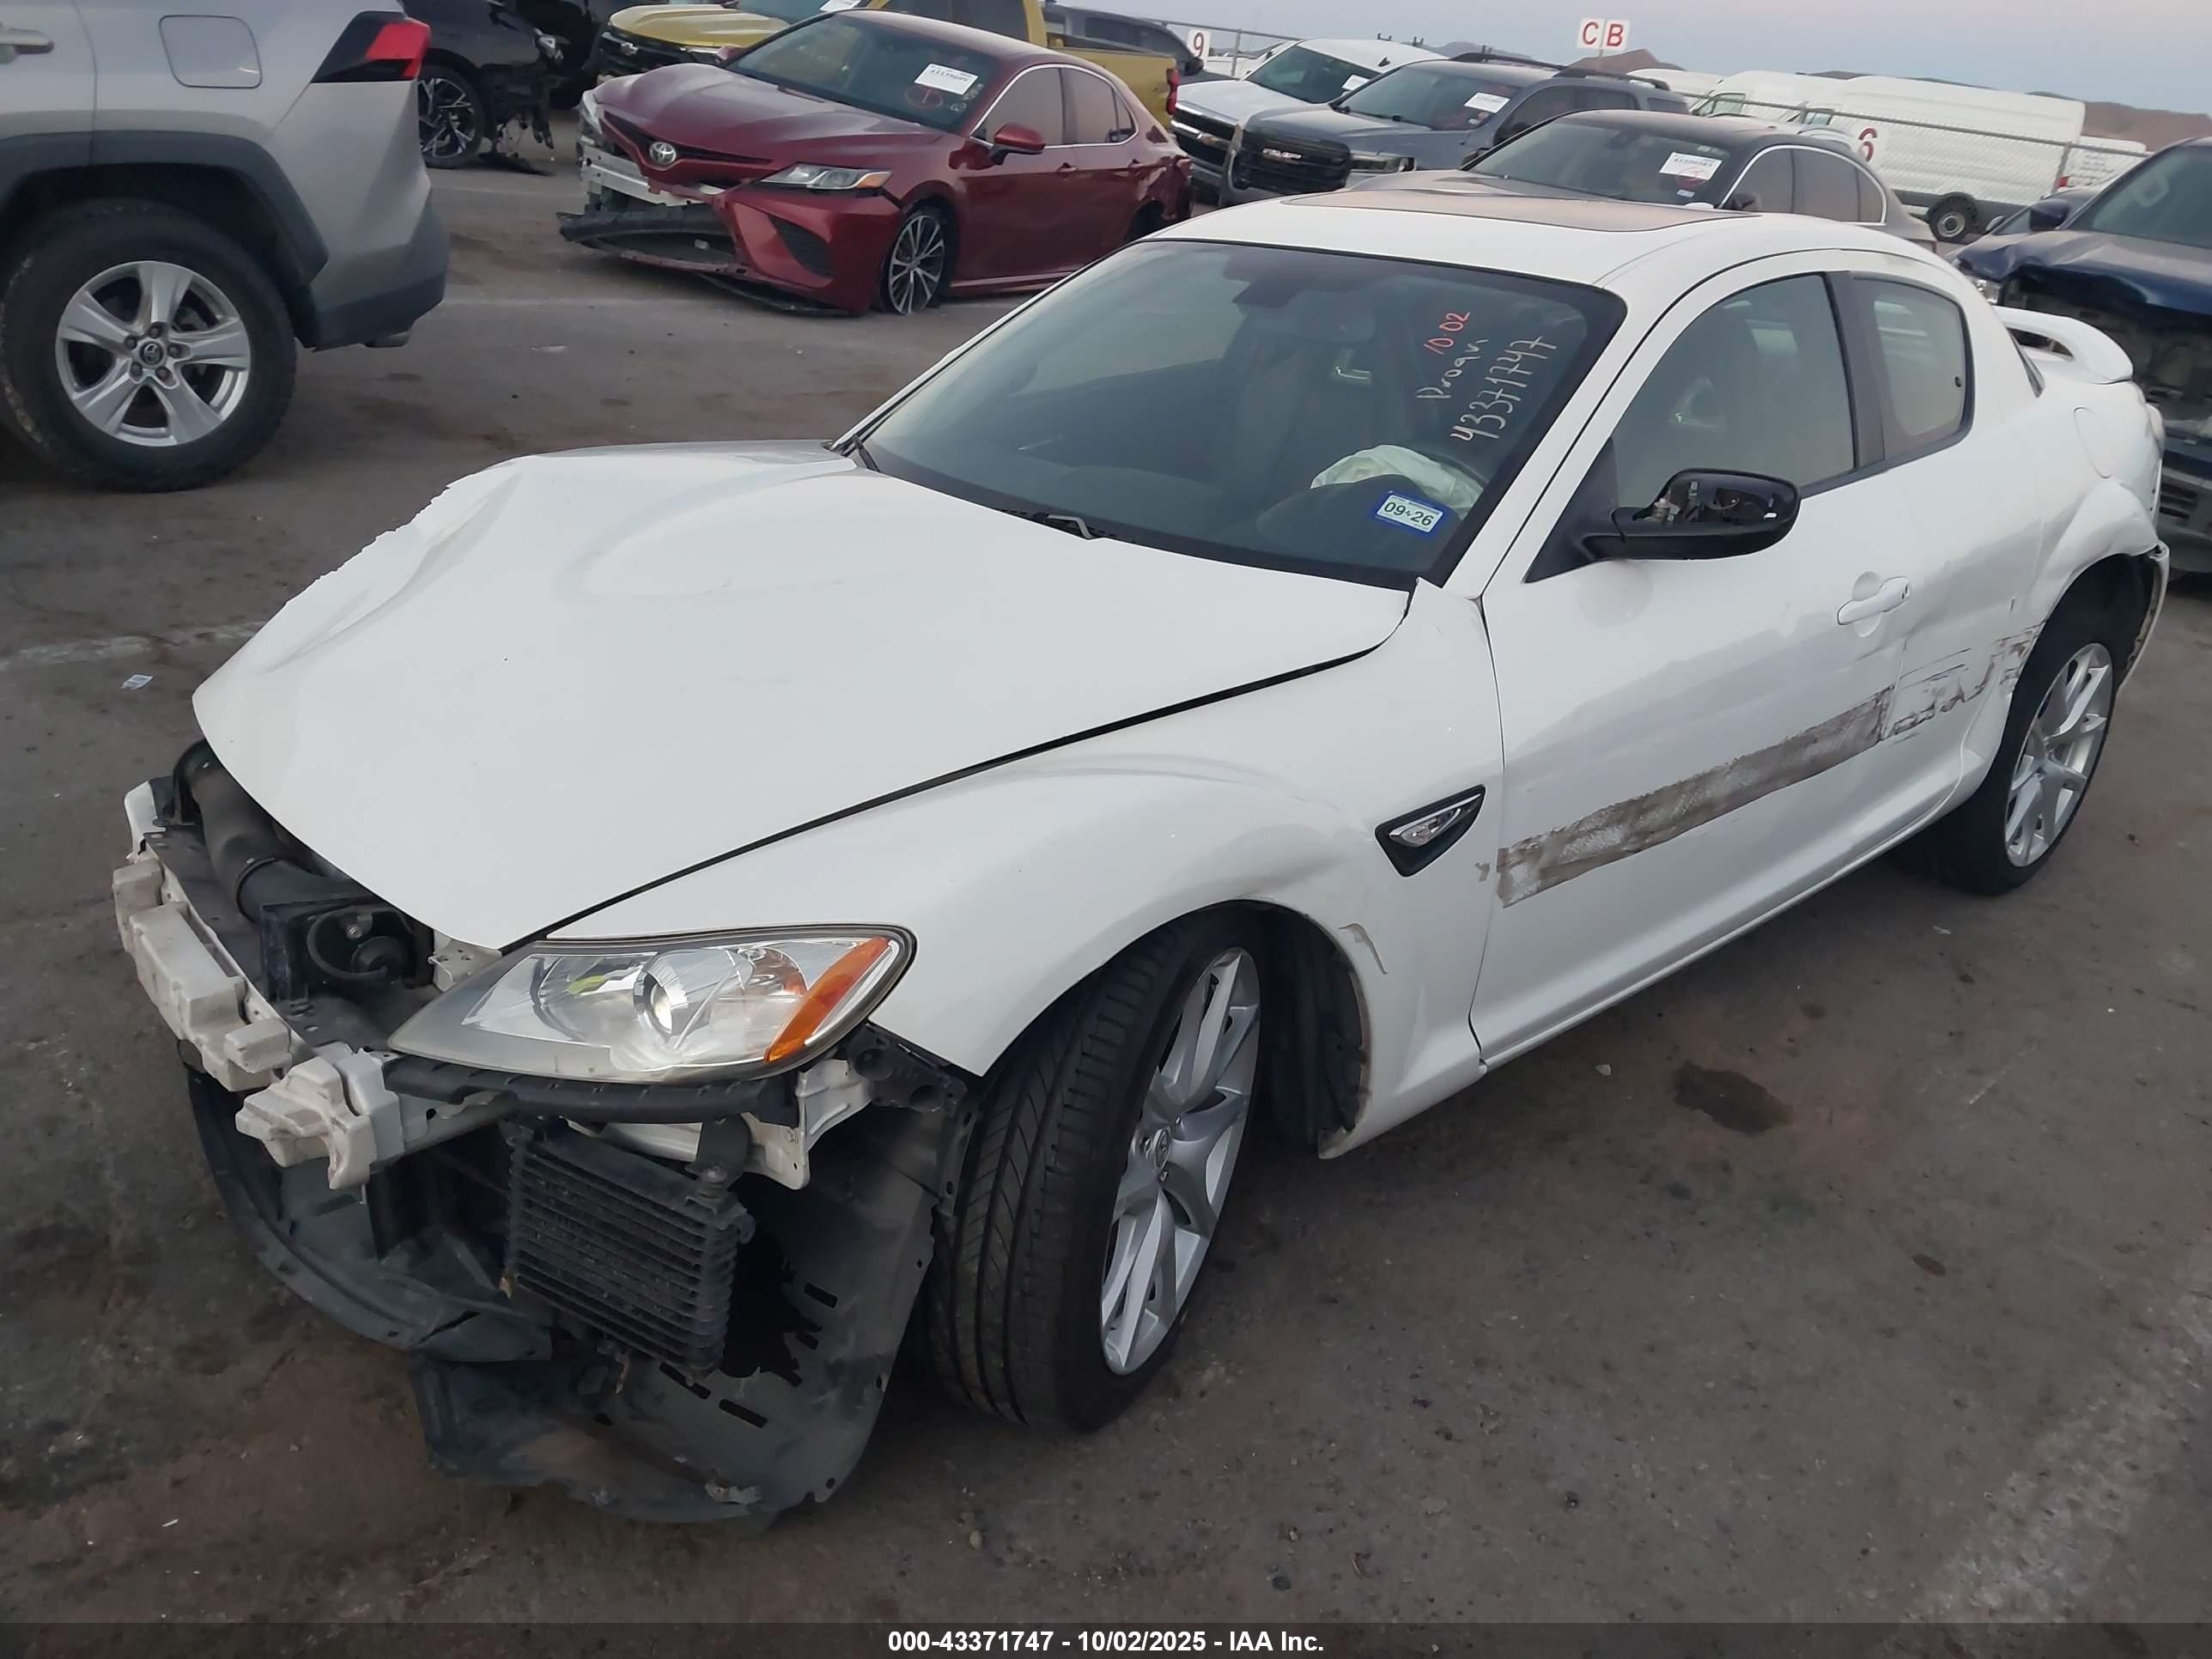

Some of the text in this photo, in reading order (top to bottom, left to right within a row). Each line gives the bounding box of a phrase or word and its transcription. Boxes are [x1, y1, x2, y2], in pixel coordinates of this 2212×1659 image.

[1194, 32, 1204, 58] 9
[1858, 128, 1877, 161] 6
[1449, 336, 1557, 441] 43371747
